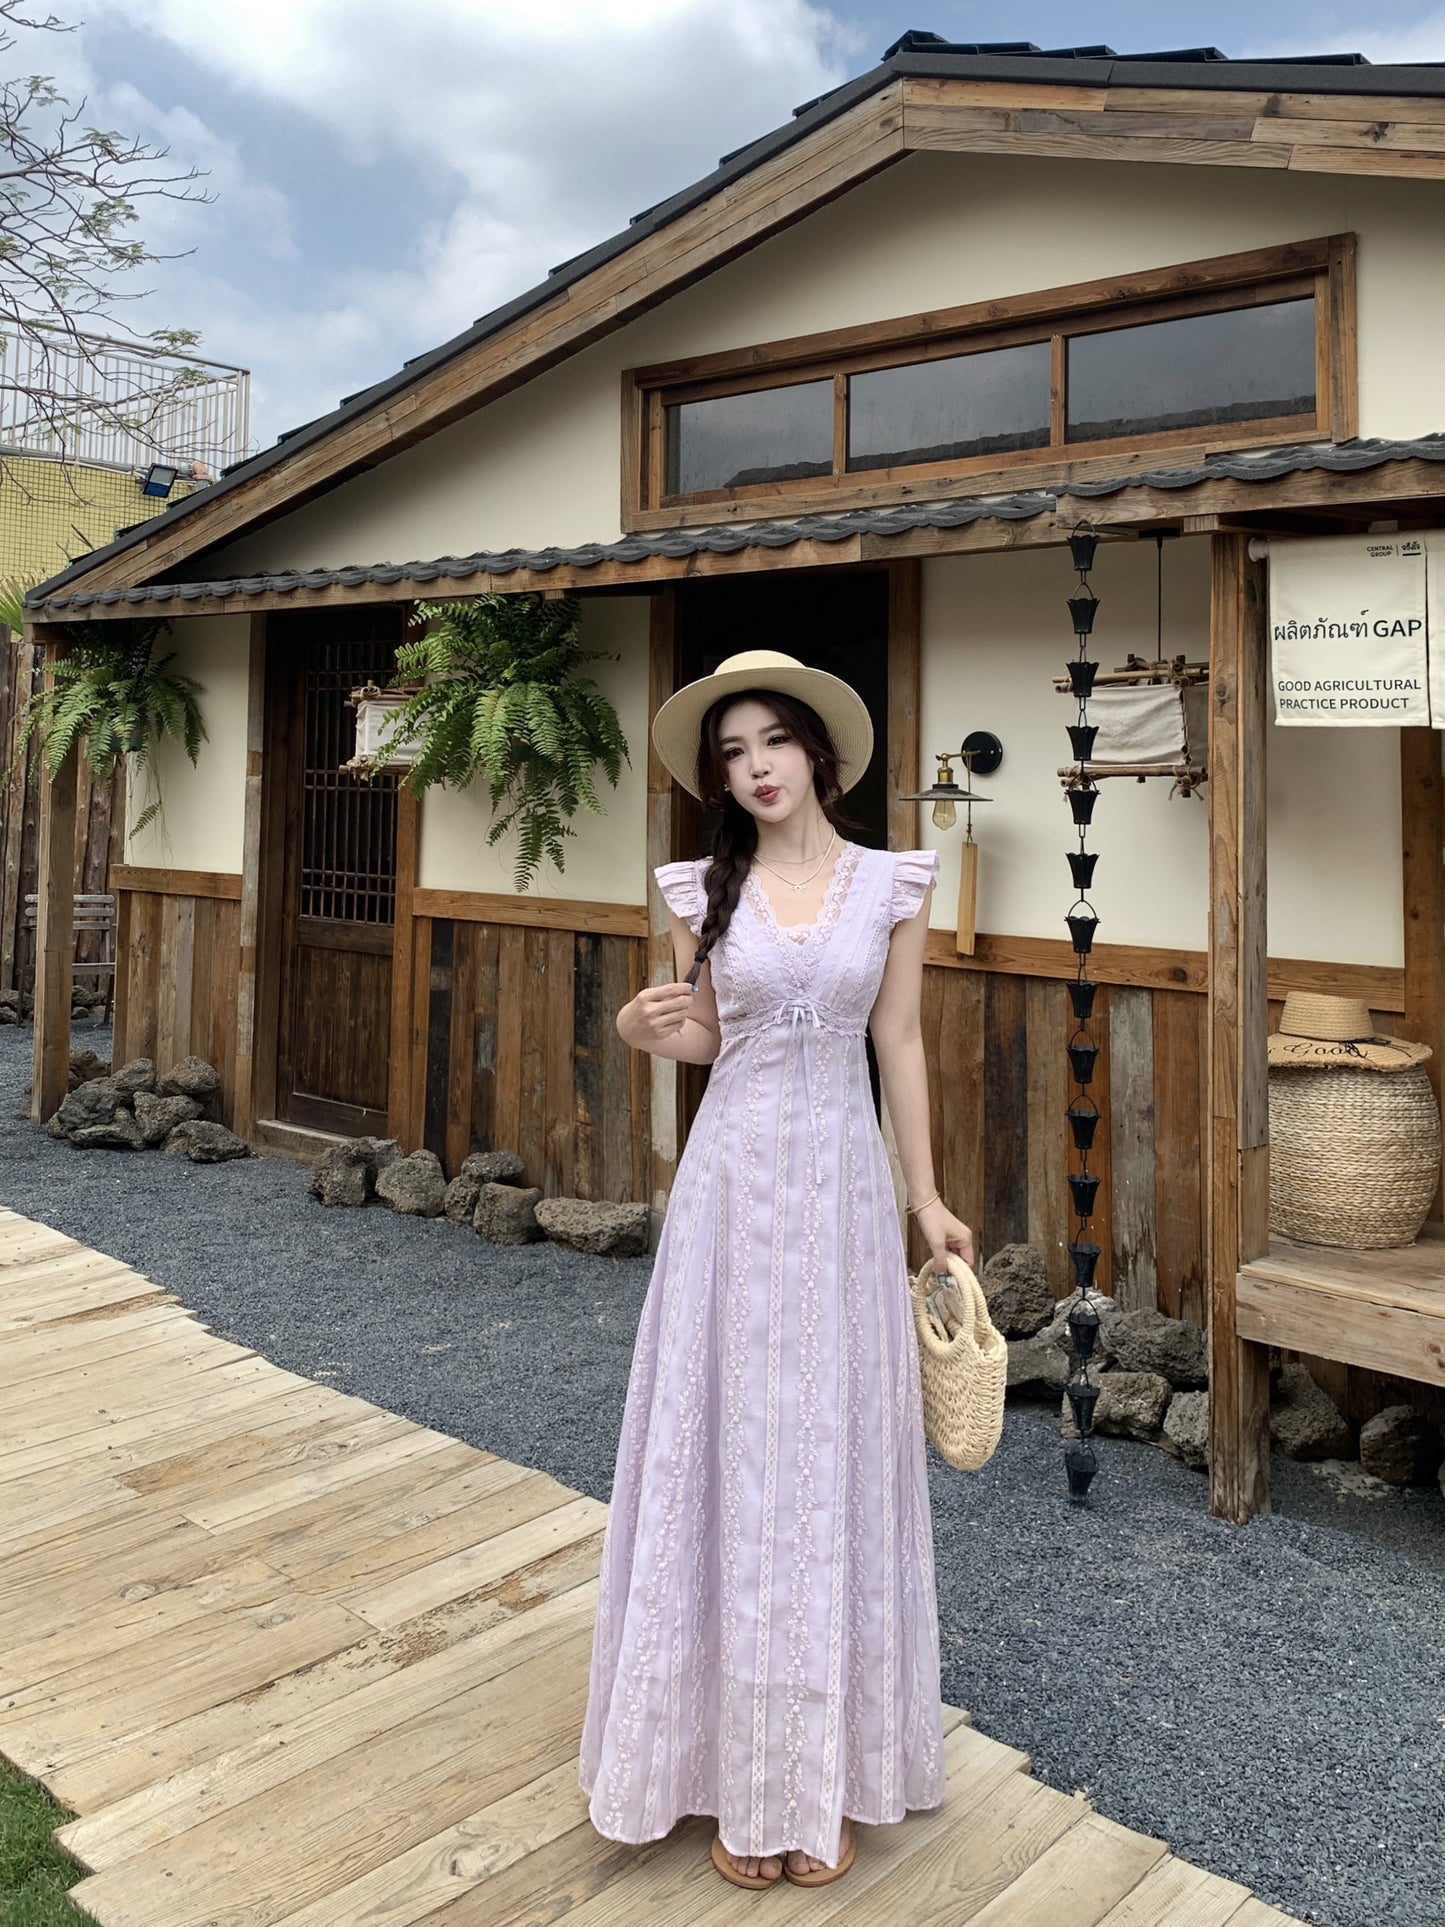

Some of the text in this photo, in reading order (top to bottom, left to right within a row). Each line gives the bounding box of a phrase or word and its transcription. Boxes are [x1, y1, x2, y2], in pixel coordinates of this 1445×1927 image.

[1275, 609, 1422, 641] ผลิตภัณฑ์ GAP
[1278, 679, 1421, 692] GOOD AGRICULTURAL
[1279, 697, 1410, 710] PRACTICE PRODUCT
